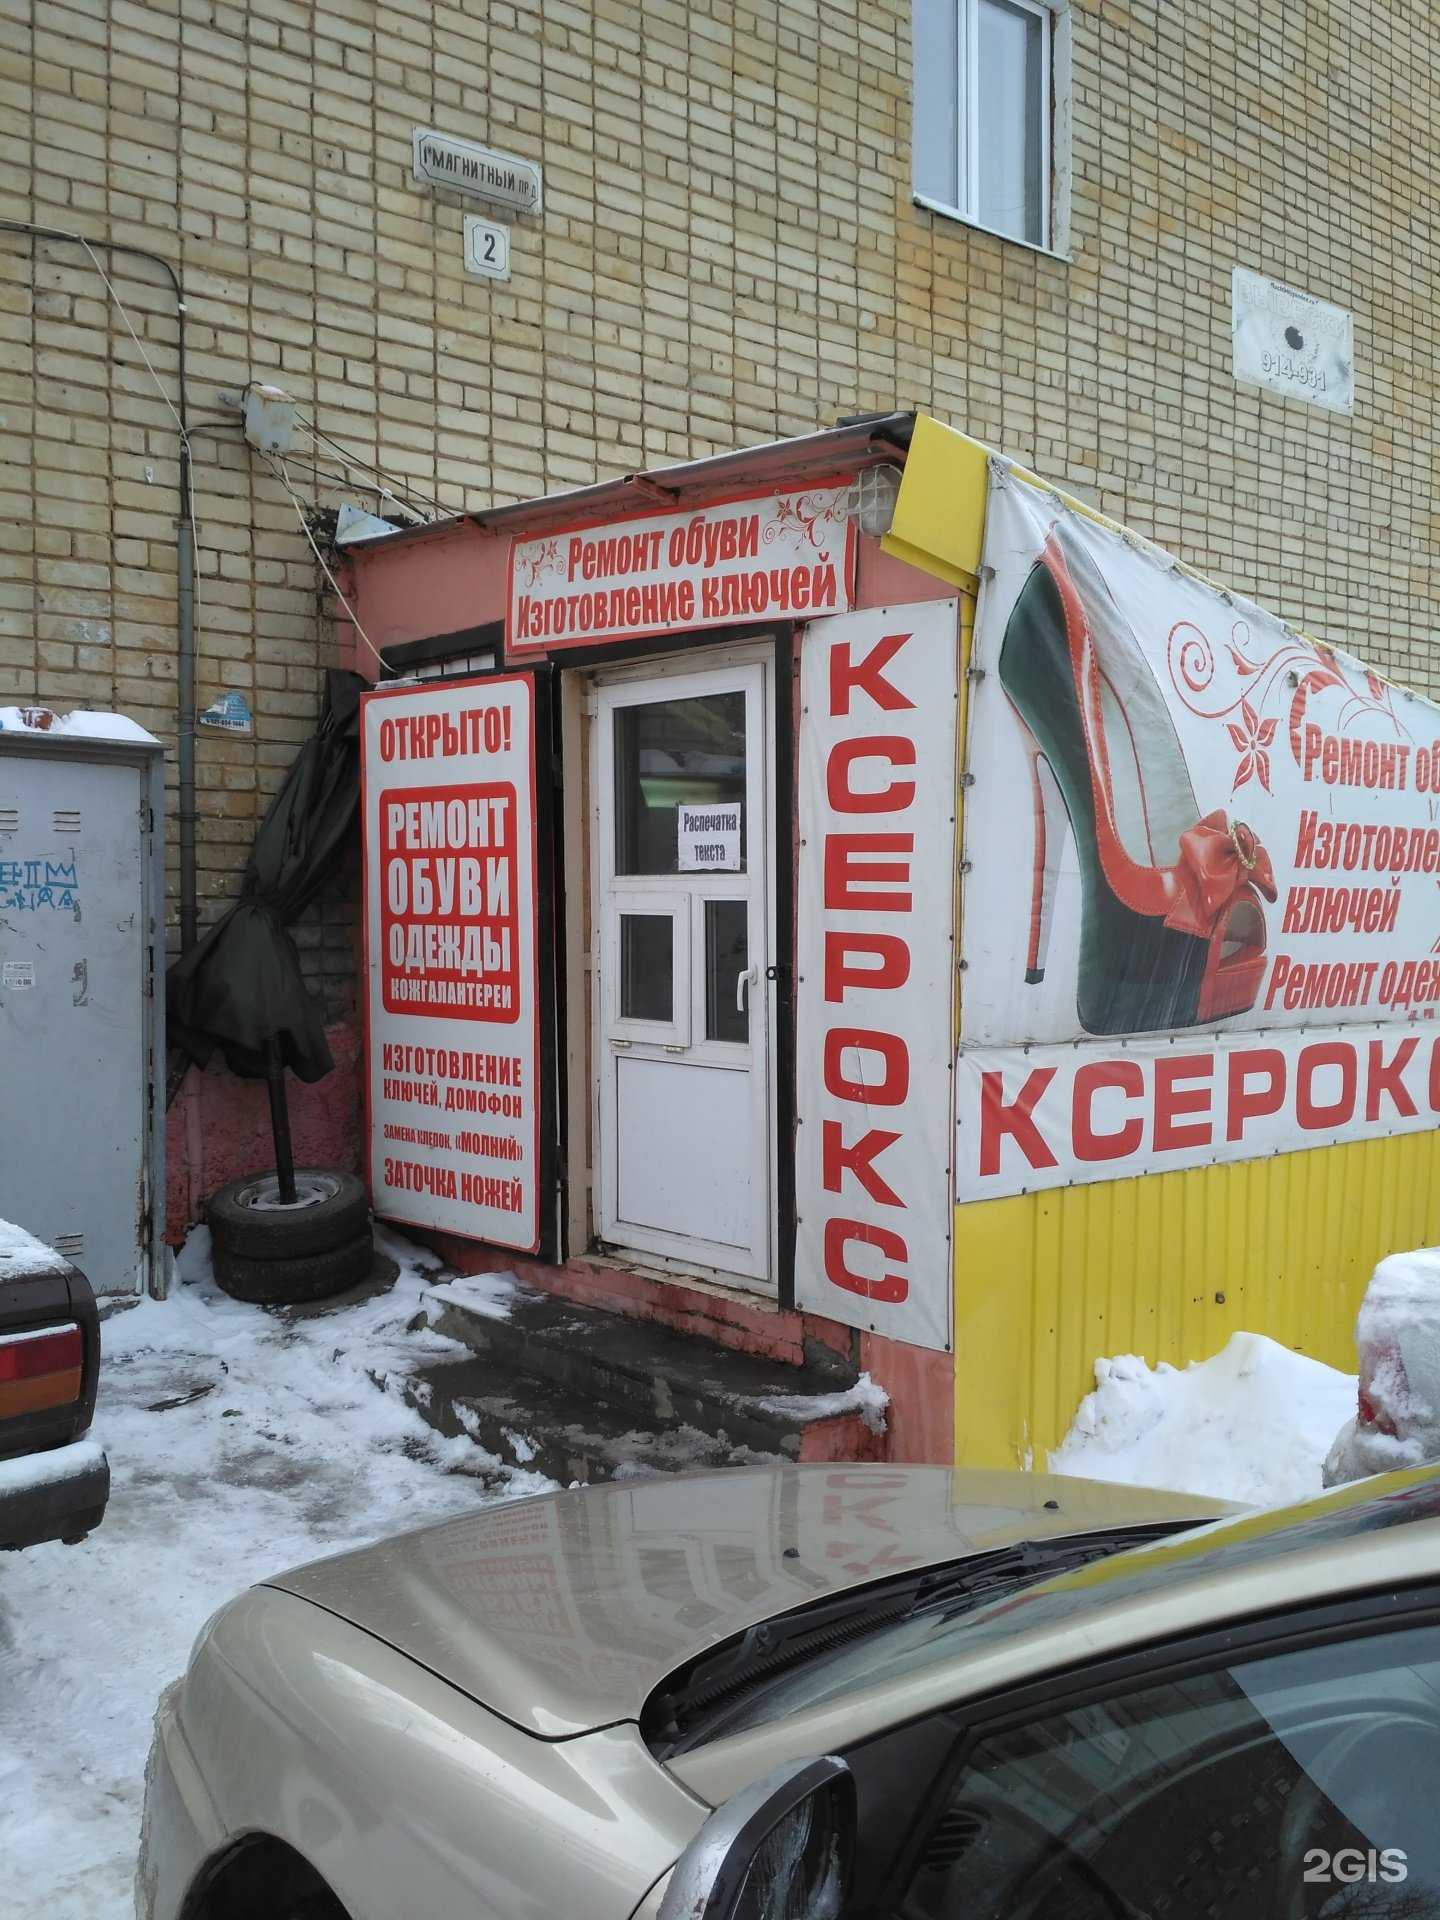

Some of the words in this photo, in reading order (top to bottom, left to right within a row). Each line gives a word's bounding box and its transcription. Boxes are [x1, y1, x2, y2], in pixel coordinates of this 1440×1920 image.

[484, 233, 497, 263] 2
[567, 530, 665, 582] Ремонт
[668, 514, 760, 569] обуви
[516, 579, 695, 639] Изготовление
[702, 551, 837, 619] ключей
[379, 705, 511, 763] ОТКРЫТО!
[1303, 722, 1411, 790] Ремонт
[386, 797, 509, 850] РЕМОНТ
[683, 812, 737, 832] Распечатка
[694, 844, 726, 861] текста
[387, 856, 510, 917] ОБУВИ
[1281, 876, 1401, 934] ключей
[389, 923, 511, 978] ОДЕЖДЫ
[822, 632, 918, 1304] КСЕРОКС
[390, 977, 512, 1009] КОЖГАЛАНТЕРЕИ
[1263, 954, 1378, 1011] Ремонт
[383, 1043, 522, 1088] ИЗГОТОВЛЕНИЕ
[383, 1078, 442, 1109] КЛЮЧЕЙ,
[445, 1086, 522, 1119] ДОМОФОН
[979, 1037, 1440, 1177] КСЕРОК
[383, 1123, 416, 1145] ЗАМЕНА
[384, 1157, 458, 1201] ЗАТОЧКА
[460, 1174, 523, 1214] НОЖЕЙ
